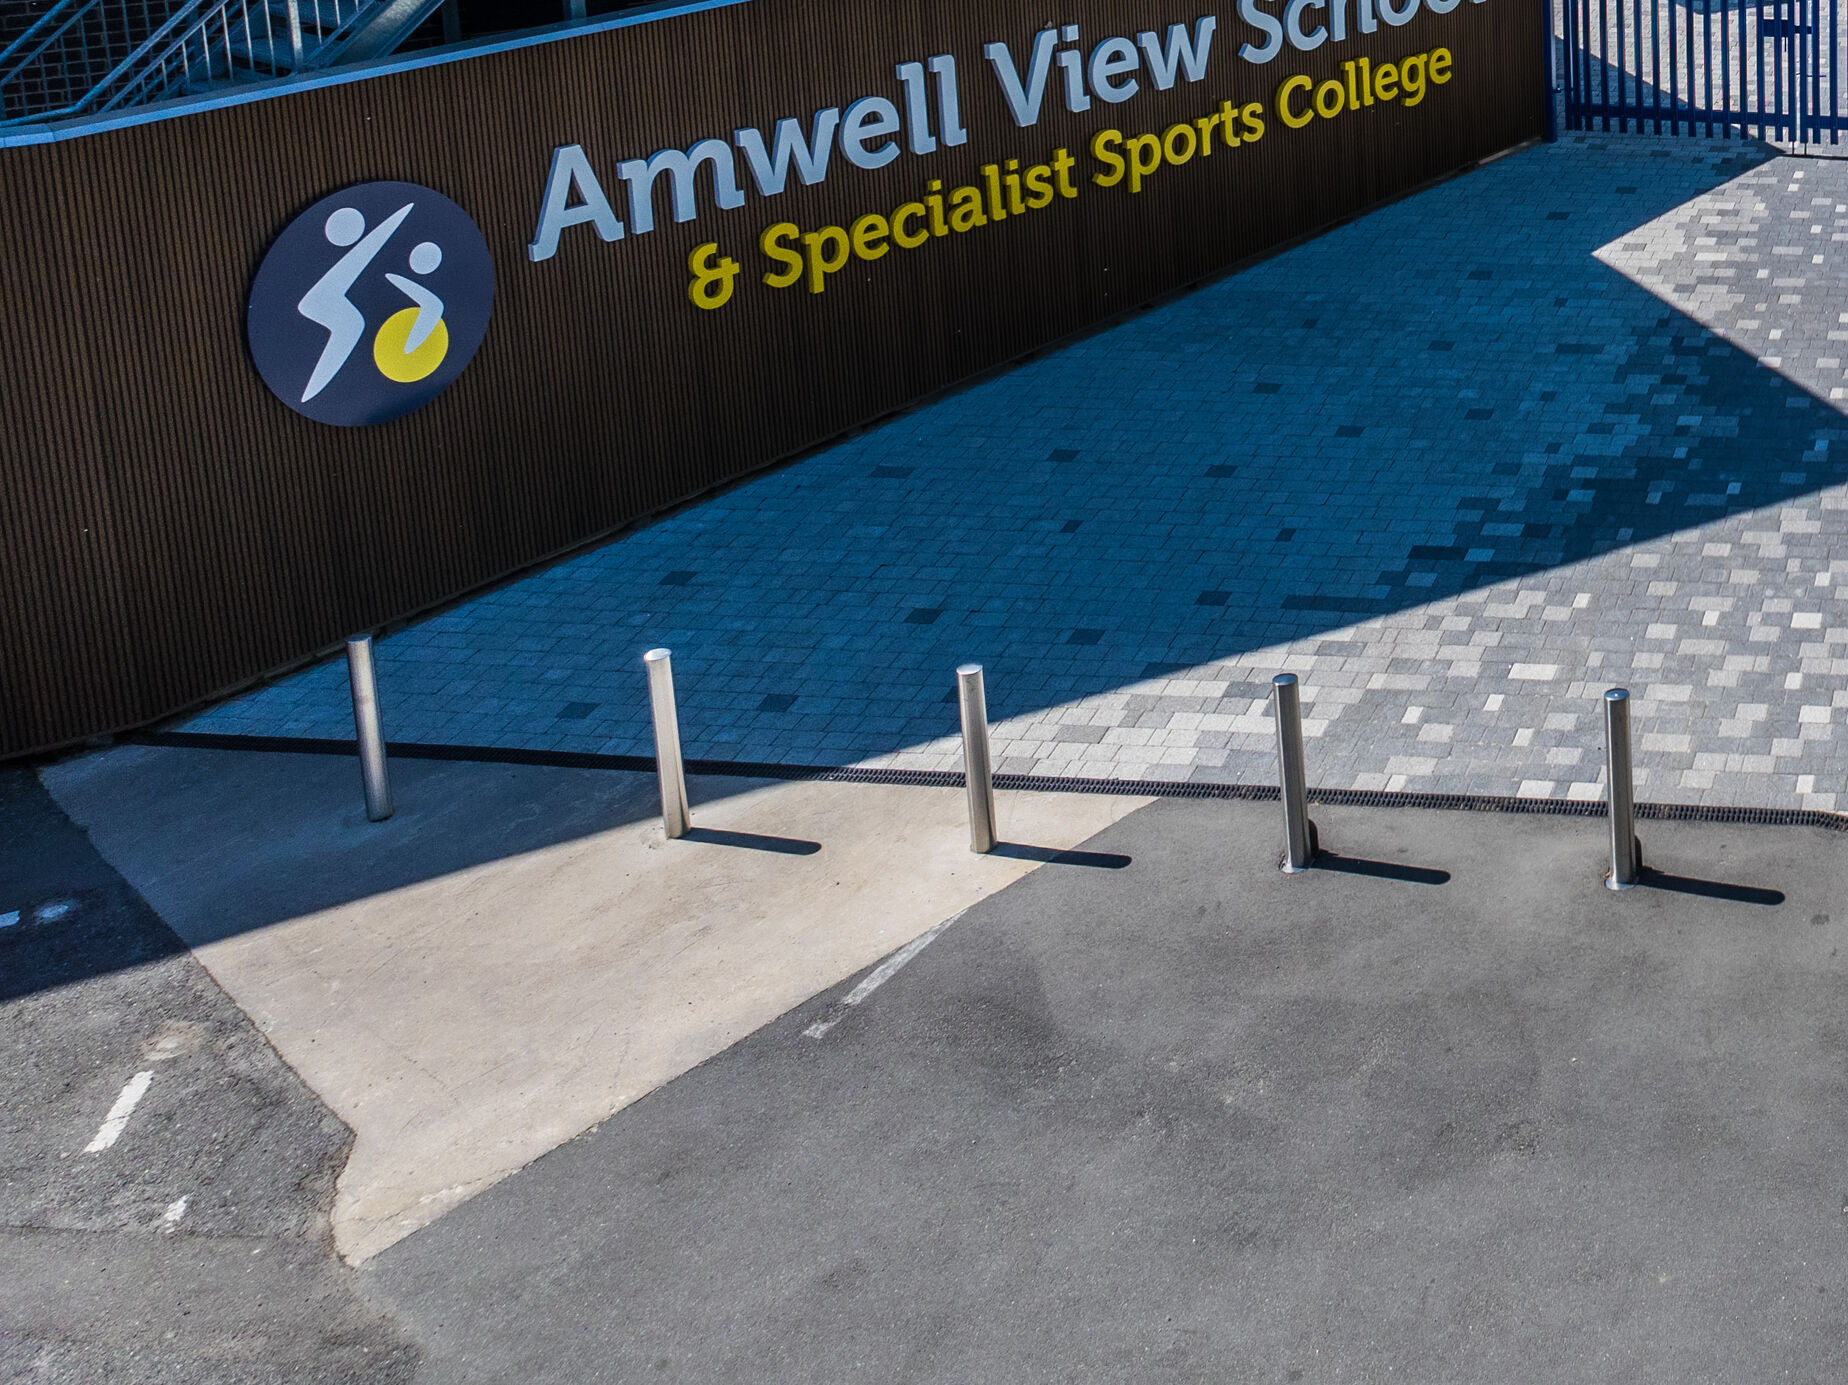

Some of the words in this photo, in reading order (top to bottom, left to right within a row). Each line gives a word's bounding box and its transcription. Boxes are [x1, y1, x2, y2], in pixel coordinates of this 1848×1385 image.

[528, 54, 967, 262] Amwell
[984, 16, 1216, 127] View
[688, 242, 740, 310] &
[759, 148, 1078, 294] Specialist
[1091, 101, 1265, 194] Sports
[1275, 47, 1453, 129] College
